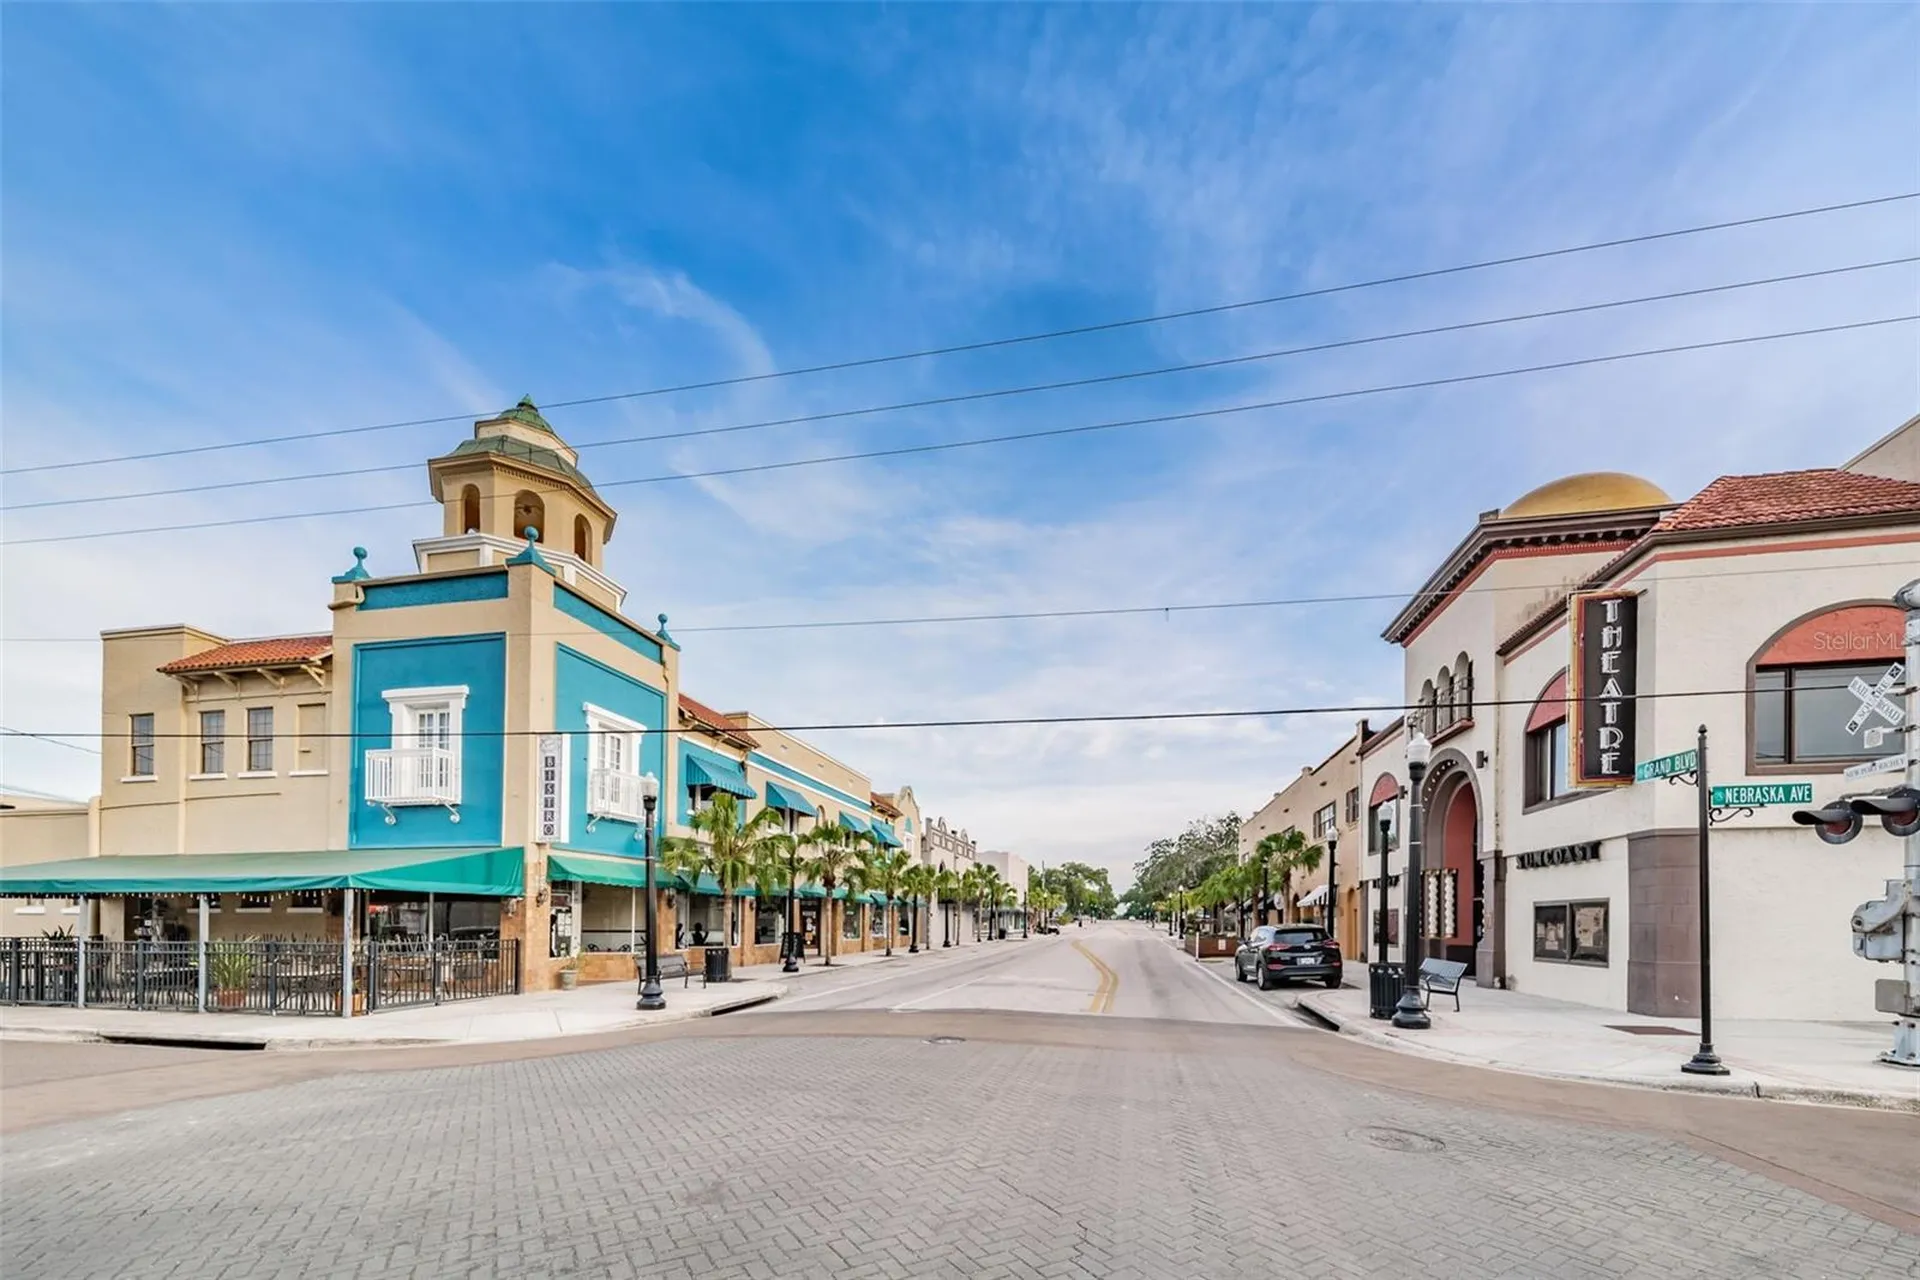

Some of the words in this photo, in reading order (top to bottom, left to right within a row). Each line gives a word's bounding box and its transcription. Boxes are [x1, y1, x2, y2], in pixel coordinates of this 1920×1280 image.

[1598, 599, 1624, 774] THEATRE
[1643, 758, 1671, 778] GRAND
[1675, 751, 1697, 771] BLVD
[543, 756, 555, 835] BISTRO
[1725, 787, 1783, 804] NEBRASKA
[1790, 785, 1811, 802] AVE
[1516, 841, 1602, 869] SUNCOAST
